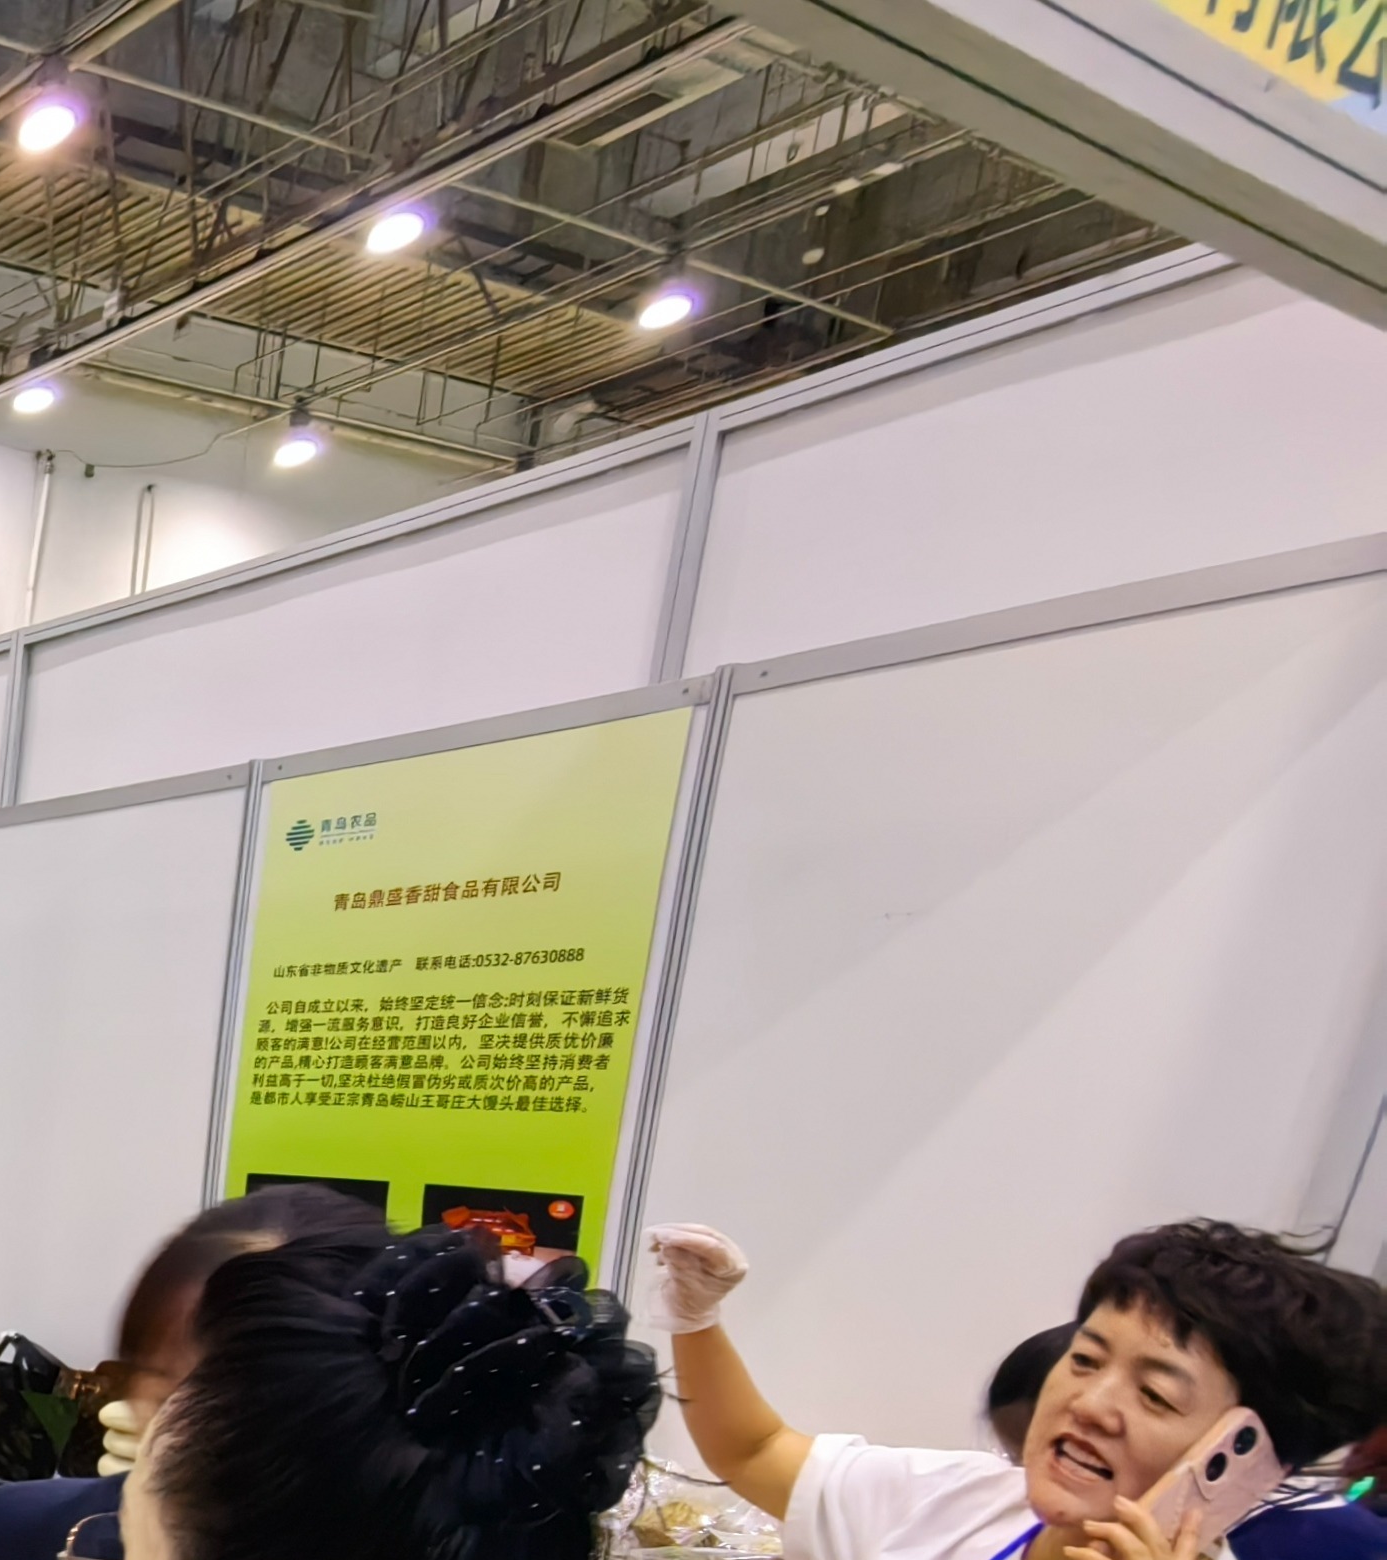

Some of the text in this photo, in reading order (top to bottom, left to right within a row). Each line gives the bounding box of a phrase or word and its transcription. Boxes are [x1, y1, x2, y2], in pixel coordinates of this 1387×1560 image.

[333, 871, 562, 912] 青岛鼎盛香甜食品有限公司
